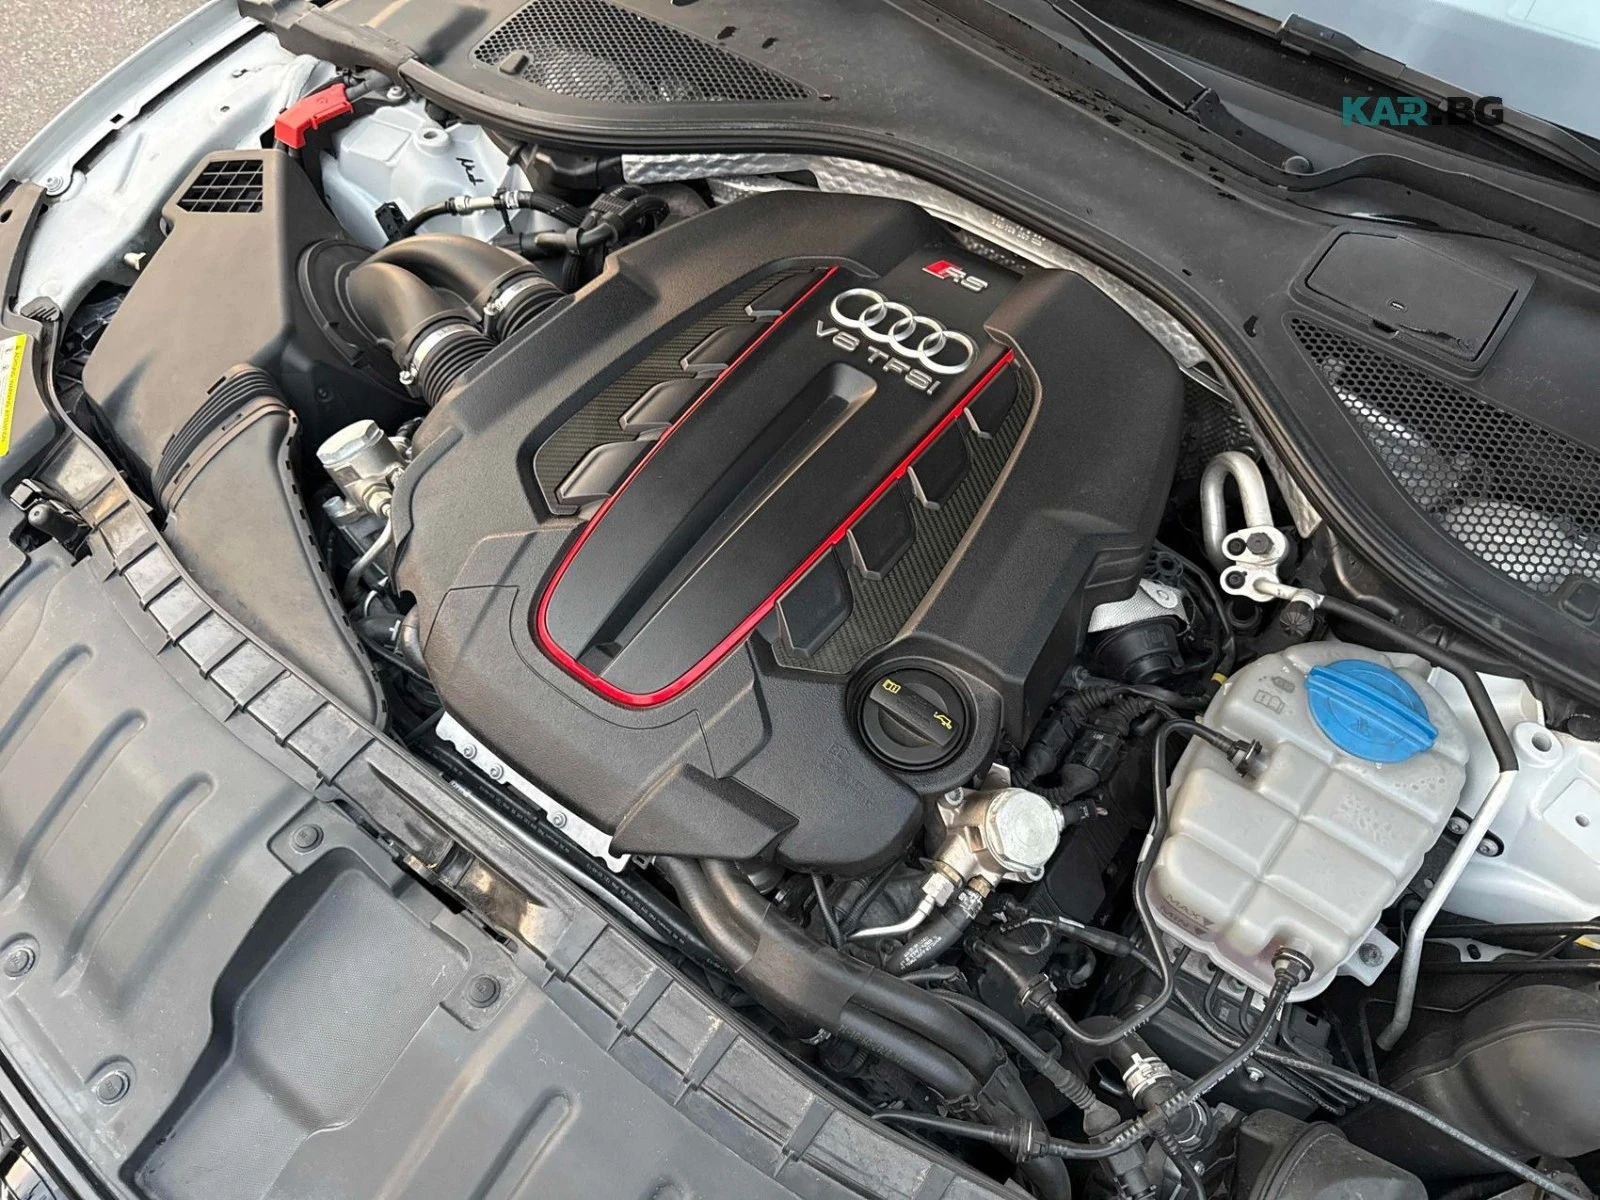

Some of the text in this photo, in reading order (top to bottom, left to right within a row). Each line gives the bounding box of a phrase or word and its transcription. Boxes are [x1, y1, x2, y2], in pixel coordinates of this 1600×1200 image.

[936, 265, 988, 292] RS
[815, 320, 941, 396] V8 TFSI
[1160, 905, 1189, 928] MIN
[1165, 894, 1201, 920] MAX
